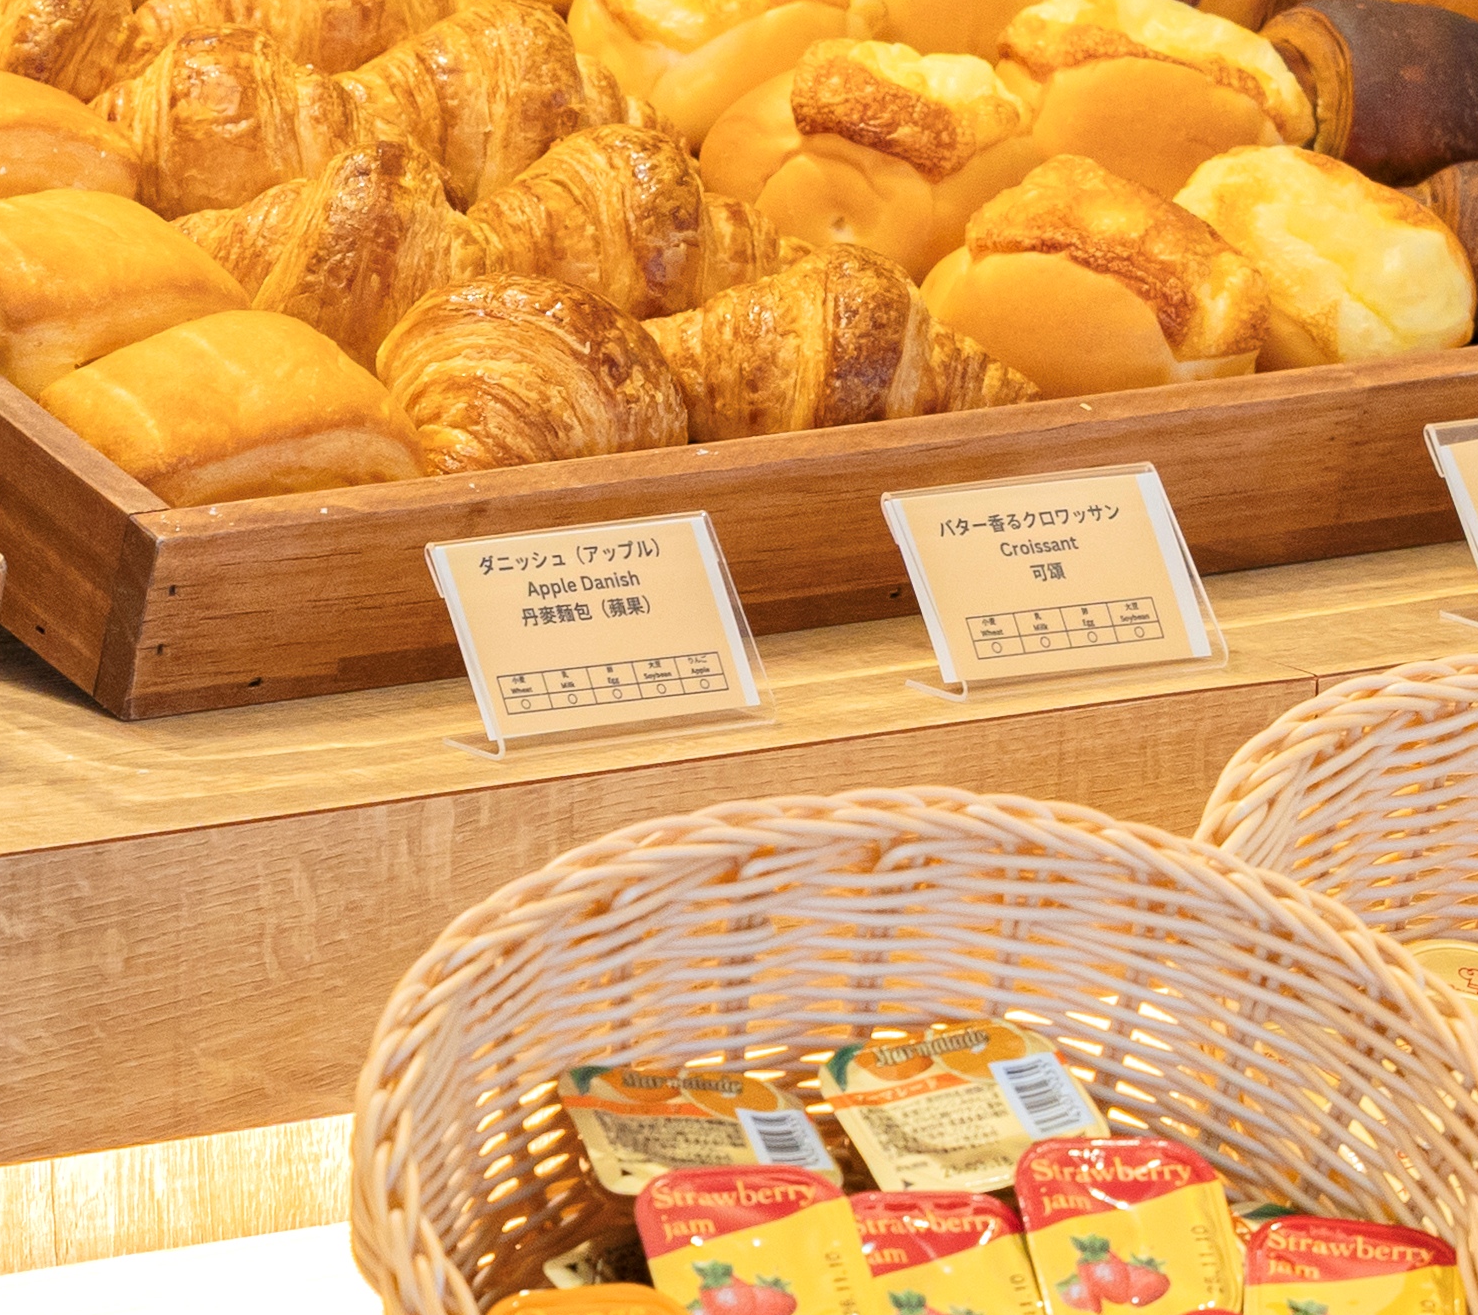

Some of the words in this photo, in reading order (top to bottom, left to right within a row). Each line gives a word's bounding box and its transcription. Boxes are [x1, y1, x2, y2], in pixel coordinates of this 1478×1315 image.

[940, 504, 1121, 539] バター香るクロワッサン
[1000, 535, 1079, 558] Croissant
[527, 581, 577, 602] Apple
[581, 571, 641, 592] Danish
[1031, 1156, 1191, 1186] Strawberry
[650, 1181, 817, 1211] Strawberry
[1041, 1190, 1093, 1215] jam
[661, 1215, 716, 1243] jam
[872, 1248, 908, 1266] am
[1267, 1231, 1435, 1266] Strawberry
[1267, 1253, 1320, 1280] jam
